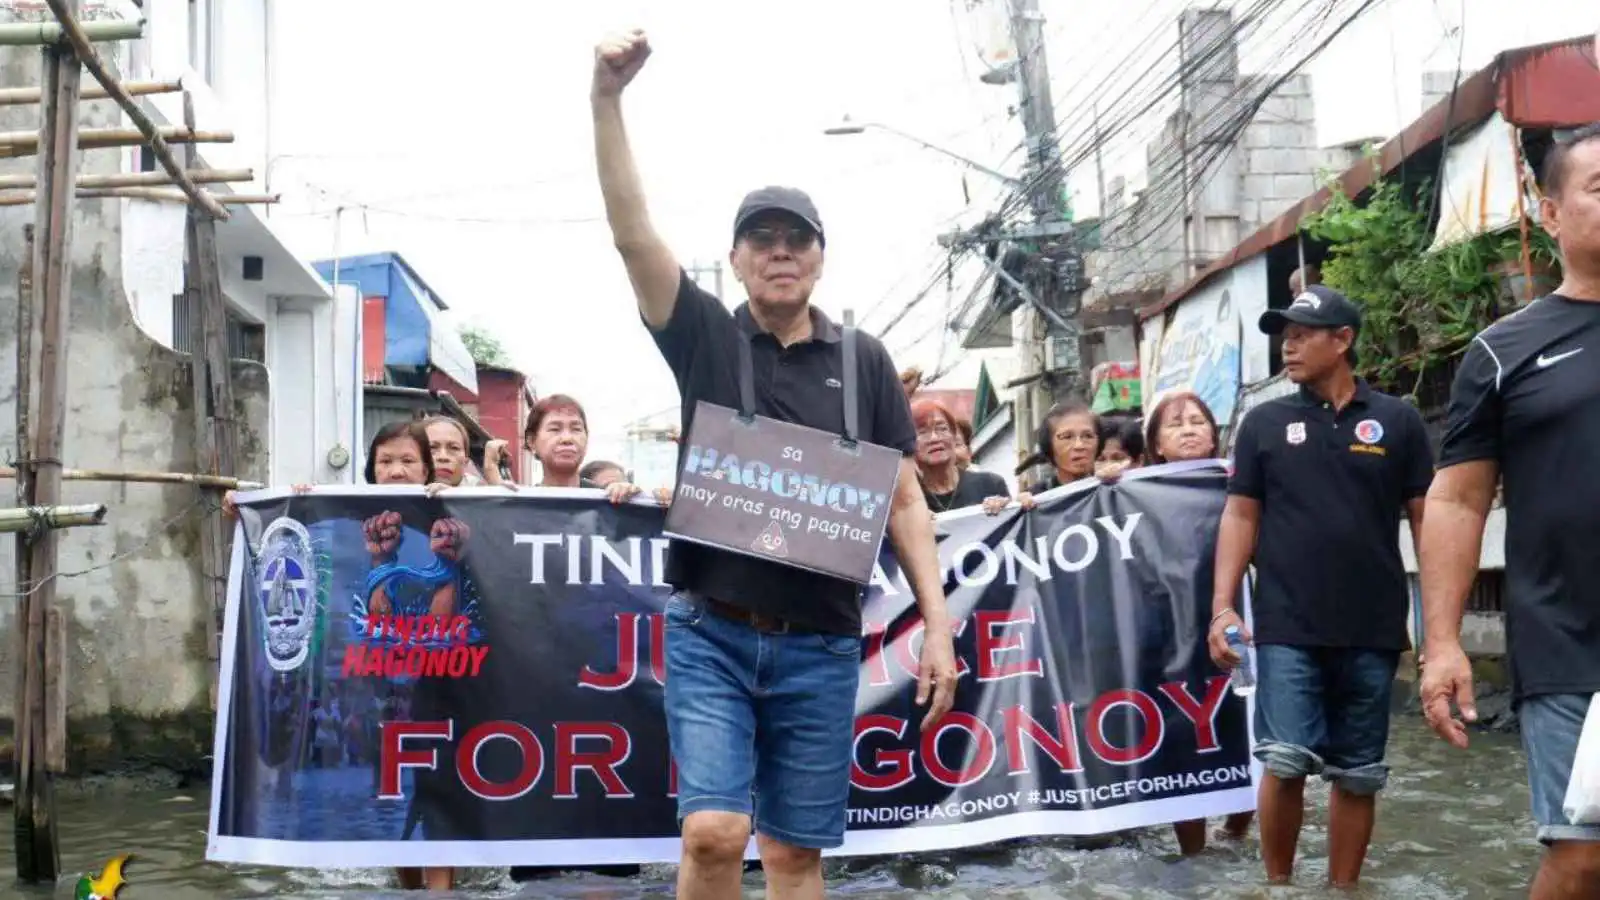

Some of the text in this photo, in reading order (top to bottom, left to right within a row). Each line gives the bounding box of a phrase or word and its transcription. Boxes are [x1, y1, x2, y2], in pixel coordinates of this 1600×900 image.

[782, 446, 803, 461] sa
[685, 446, 886, 519] HAGONOY
[680, 483, 873, 543] may oras ang pagtae
[513, 532, 672, 587] TIN
[340, 645, 489, 680] HAGONOY
[377, 719, 635, 800] FOR
